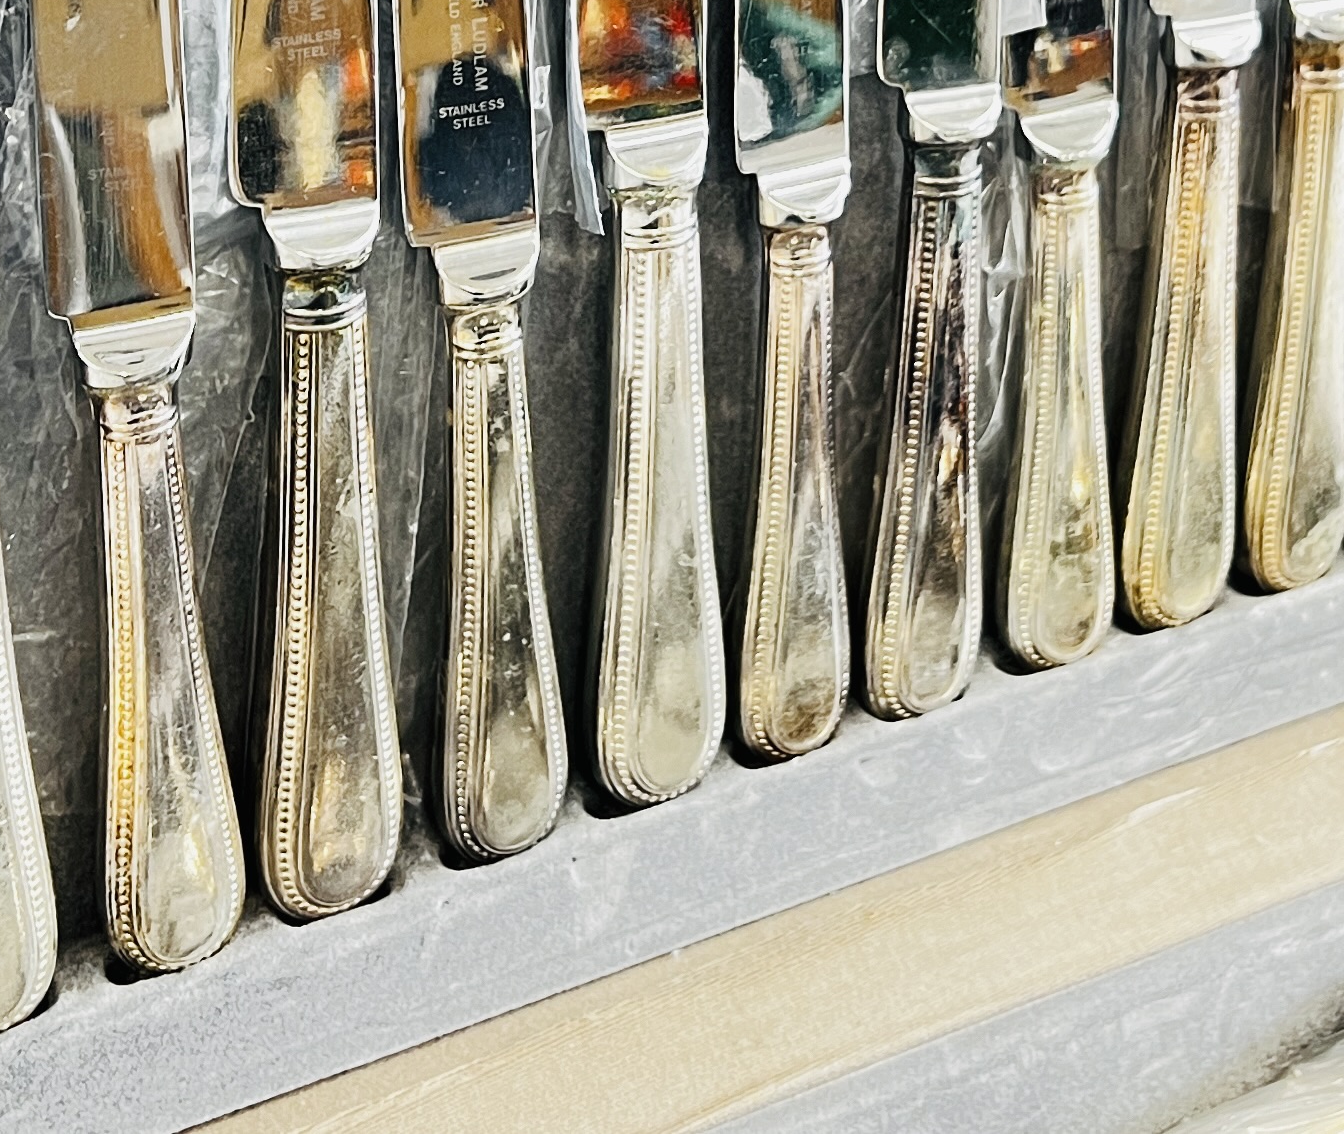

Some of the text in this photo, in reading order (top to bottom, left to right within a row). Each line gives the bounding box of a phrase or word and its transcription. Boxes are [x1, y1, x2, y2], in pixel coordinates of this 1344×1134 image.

[272, 28, 342, 50] STAINLESS
[286, 44, 329, 61] STEEL
[449, 23, 464, 86] ENGLAND
[470, 17, 489, 92] LUDLAM
[438, 97, 505, 119] STAINLESS
[452, 114, 492, 130] STEEL
